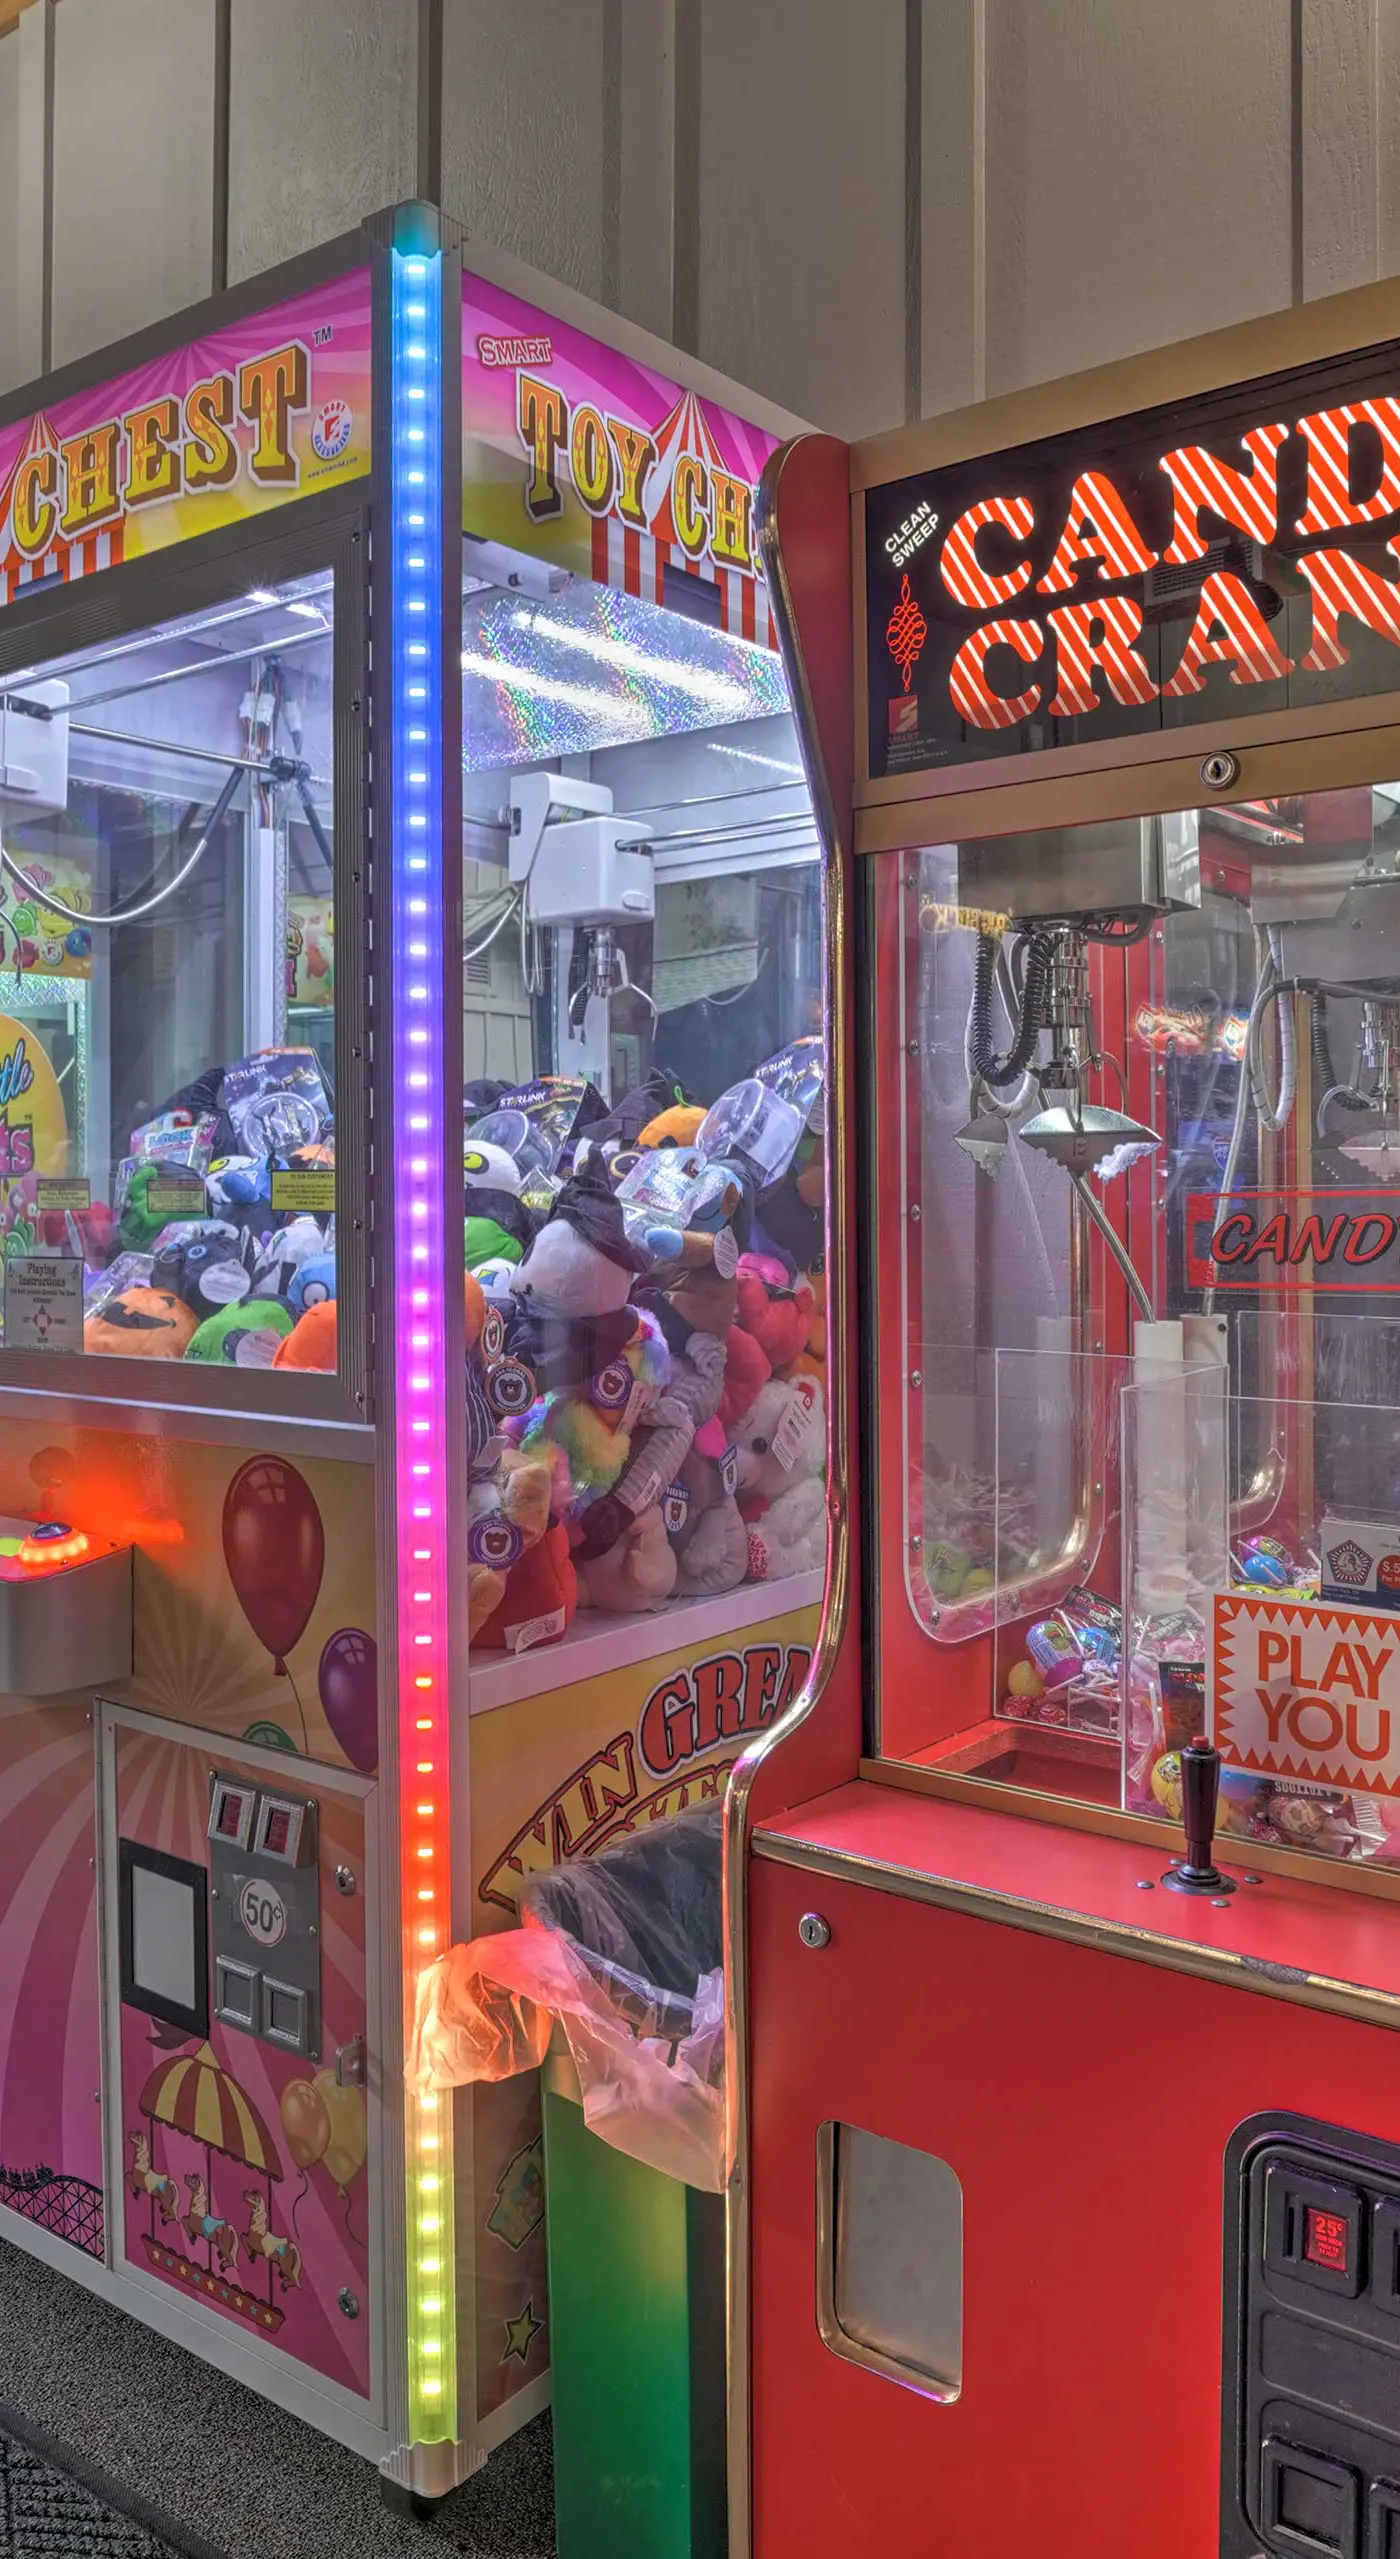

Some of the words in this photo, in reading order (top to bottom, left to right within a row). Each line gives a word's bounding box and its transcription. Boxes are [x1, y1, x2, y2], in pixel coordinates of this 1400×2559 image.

[313, 325, 332, 345] TM
[479, 336, 553, 366] SMART
[12, 339, 312, 559] CHEST
[517, 370, 658, 533] TOY
[672, 450, 767, 583] CH
[885, 501, 931, 552] CLEAN
[892, 513, 938, 567] SWEEP
[1211, 1212, 1400, 1266] CAND
[19, 1275, 66, 1287] Instructions
[28, 1263, 57, 1277] Playing
[1258, 1630, 1393, 1700] PLAY
[1255, 1688, 1390, 1762] YOU
[479, 1732, 638, 1907] WIN
[246, 1891, 282, 1934] 50¢
